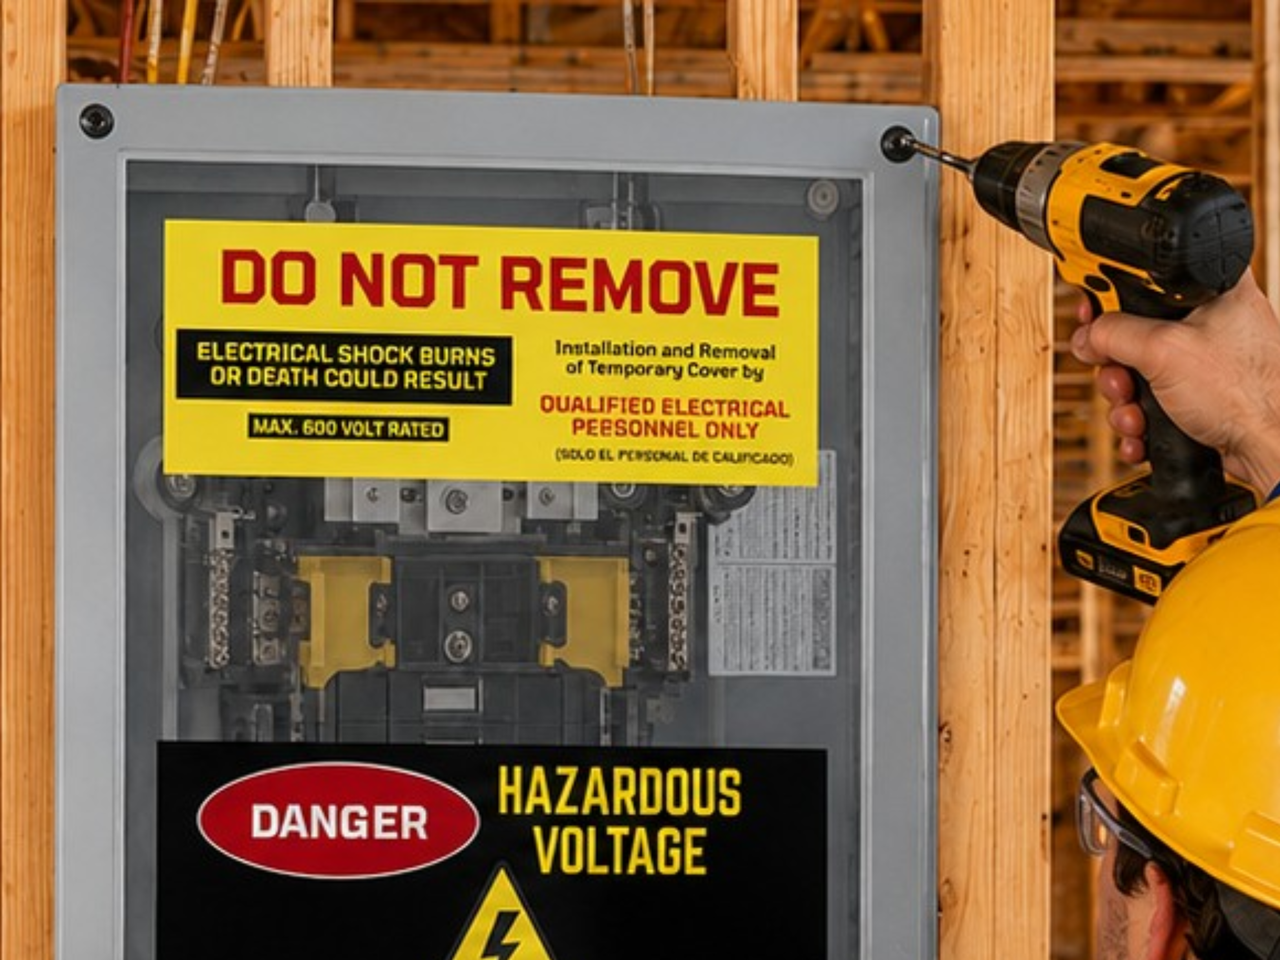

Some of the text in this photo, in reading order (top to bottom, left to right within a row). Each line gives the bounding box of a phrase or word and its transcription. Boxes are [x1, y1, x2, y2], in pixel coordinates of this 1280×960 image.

[222, 250, 779, 317] DO NOT REMOVE
[198, 342, 495, 366] ELECTRICAL SHOCK BURNS
[556, 340, 775, 360] Installation and Removal
[211, 366, 487, 390] OR DEATH COULD RESULT
[566, 360, 764, 382] of Temporary Cover by
[662, 398, 790, 418] ELECTRICAL
[253, 418, 444, 439] MAX. 600 VOLT RATED
[706, 421, 758, 439] ONLY
[599, 449, 613, 461] EL
[500, 766, 740, 816] HAZARDOUS
[252, 804, 426, 839] DANGER
[533, 826, 706, 874] VOLTAGE
